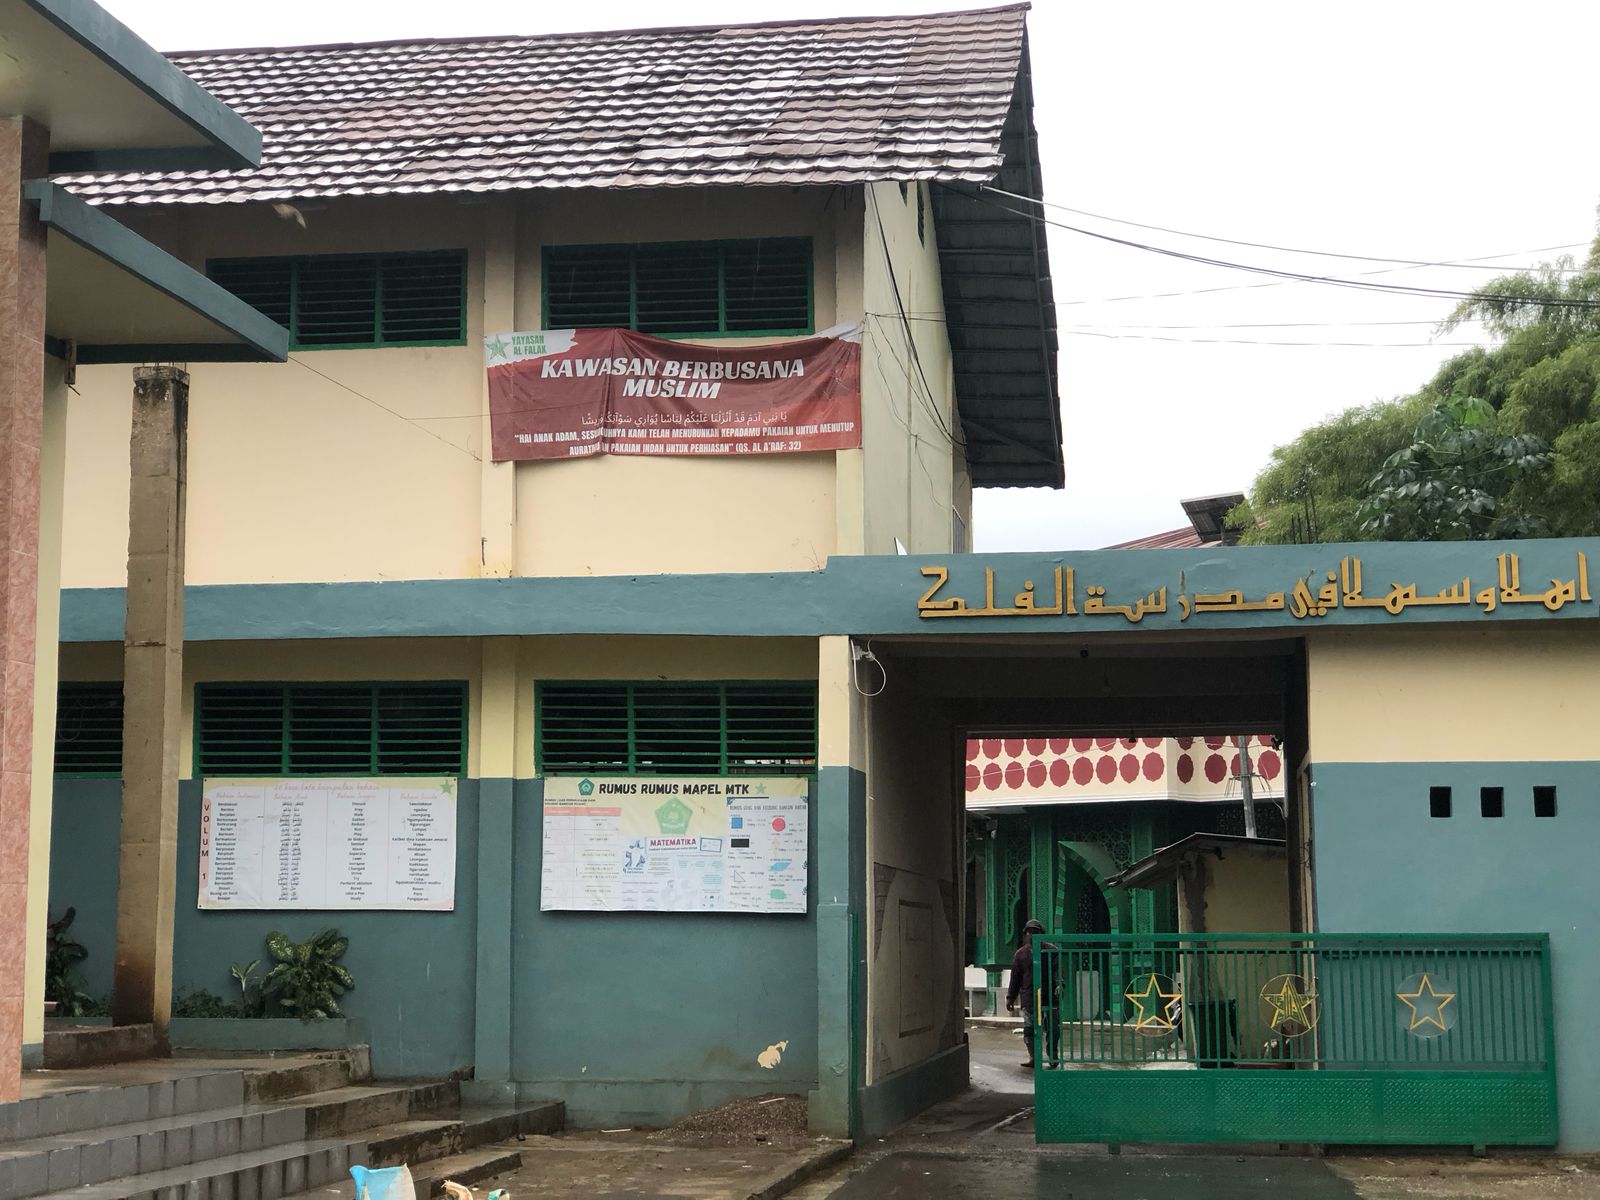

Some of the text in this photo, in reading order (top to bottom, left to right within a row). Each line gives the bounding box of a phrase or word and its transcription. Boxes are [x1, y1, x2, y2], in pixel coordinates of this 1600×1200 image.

[511, 335, 545, 346] YAYASAN
[513, 345, 547, 355] AL FALAK
[541, 357, 805, 380] KAWASAN BERBUSANA
[622, 378, 722, 400] MUSLIM
[534, 432, 553, 443] ANAK
[555, 431, 580, 442] ADAM,
[628, 428, 646, 438] KAMI
[649, 428, 670, 438] TELAH
[672, 428, 719, 438] MENURUNKAN
[721, 427, 760, 438] KEPADAMU
[763, 426, 794, 437] PAKAIAN
[796, 424, 819, 435] UNTUK
[820, 422, 854, 433] MENUTUP
[611, 443, 641, 453] PAKAIAN
[643, 443, 664, 453] INDAH
[666, 443, 689, 453] UNTUK
[752, 442, 762, 452] AL
[788, 441, 802, 450] 32)
[1497, 551, 1593, 611] اهلا
[1084, 582, 1285, 623] مدرسة
[599, 783, 750, 795] RUMUS RUMUS MAPEL MTK
[202, 803, 210, 857] VOLUM
[650, 838, 697, 847] MATEMATIKA
